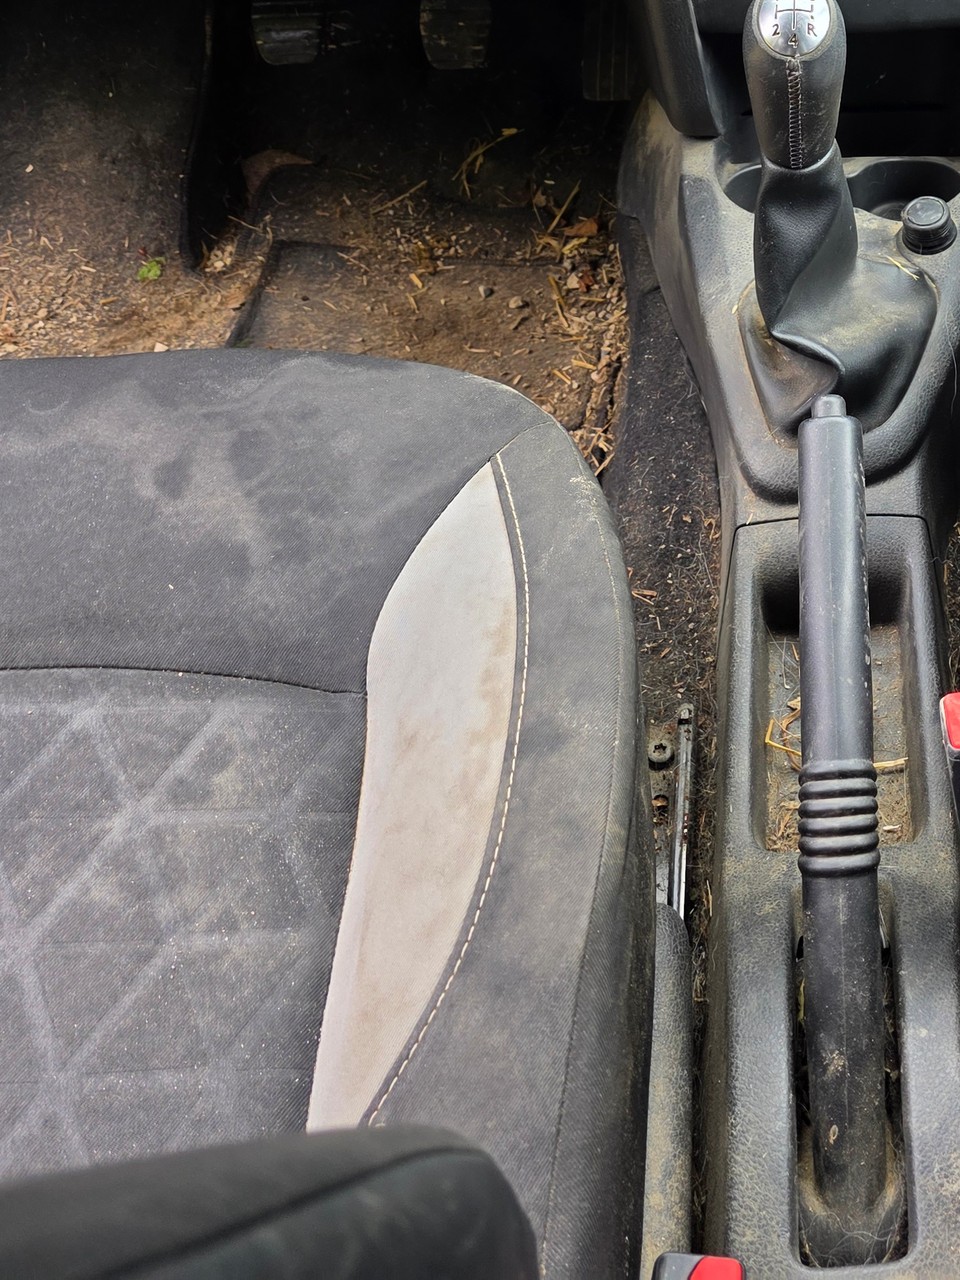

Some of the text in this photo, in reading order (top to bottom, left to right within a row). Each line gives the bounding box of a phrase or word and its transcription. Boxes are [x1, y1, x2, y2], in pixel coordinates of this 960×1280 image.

[771, 23, 781, 37] 2
[806, 22, 818, 38] R
[788, 32, 799, 49] 4
